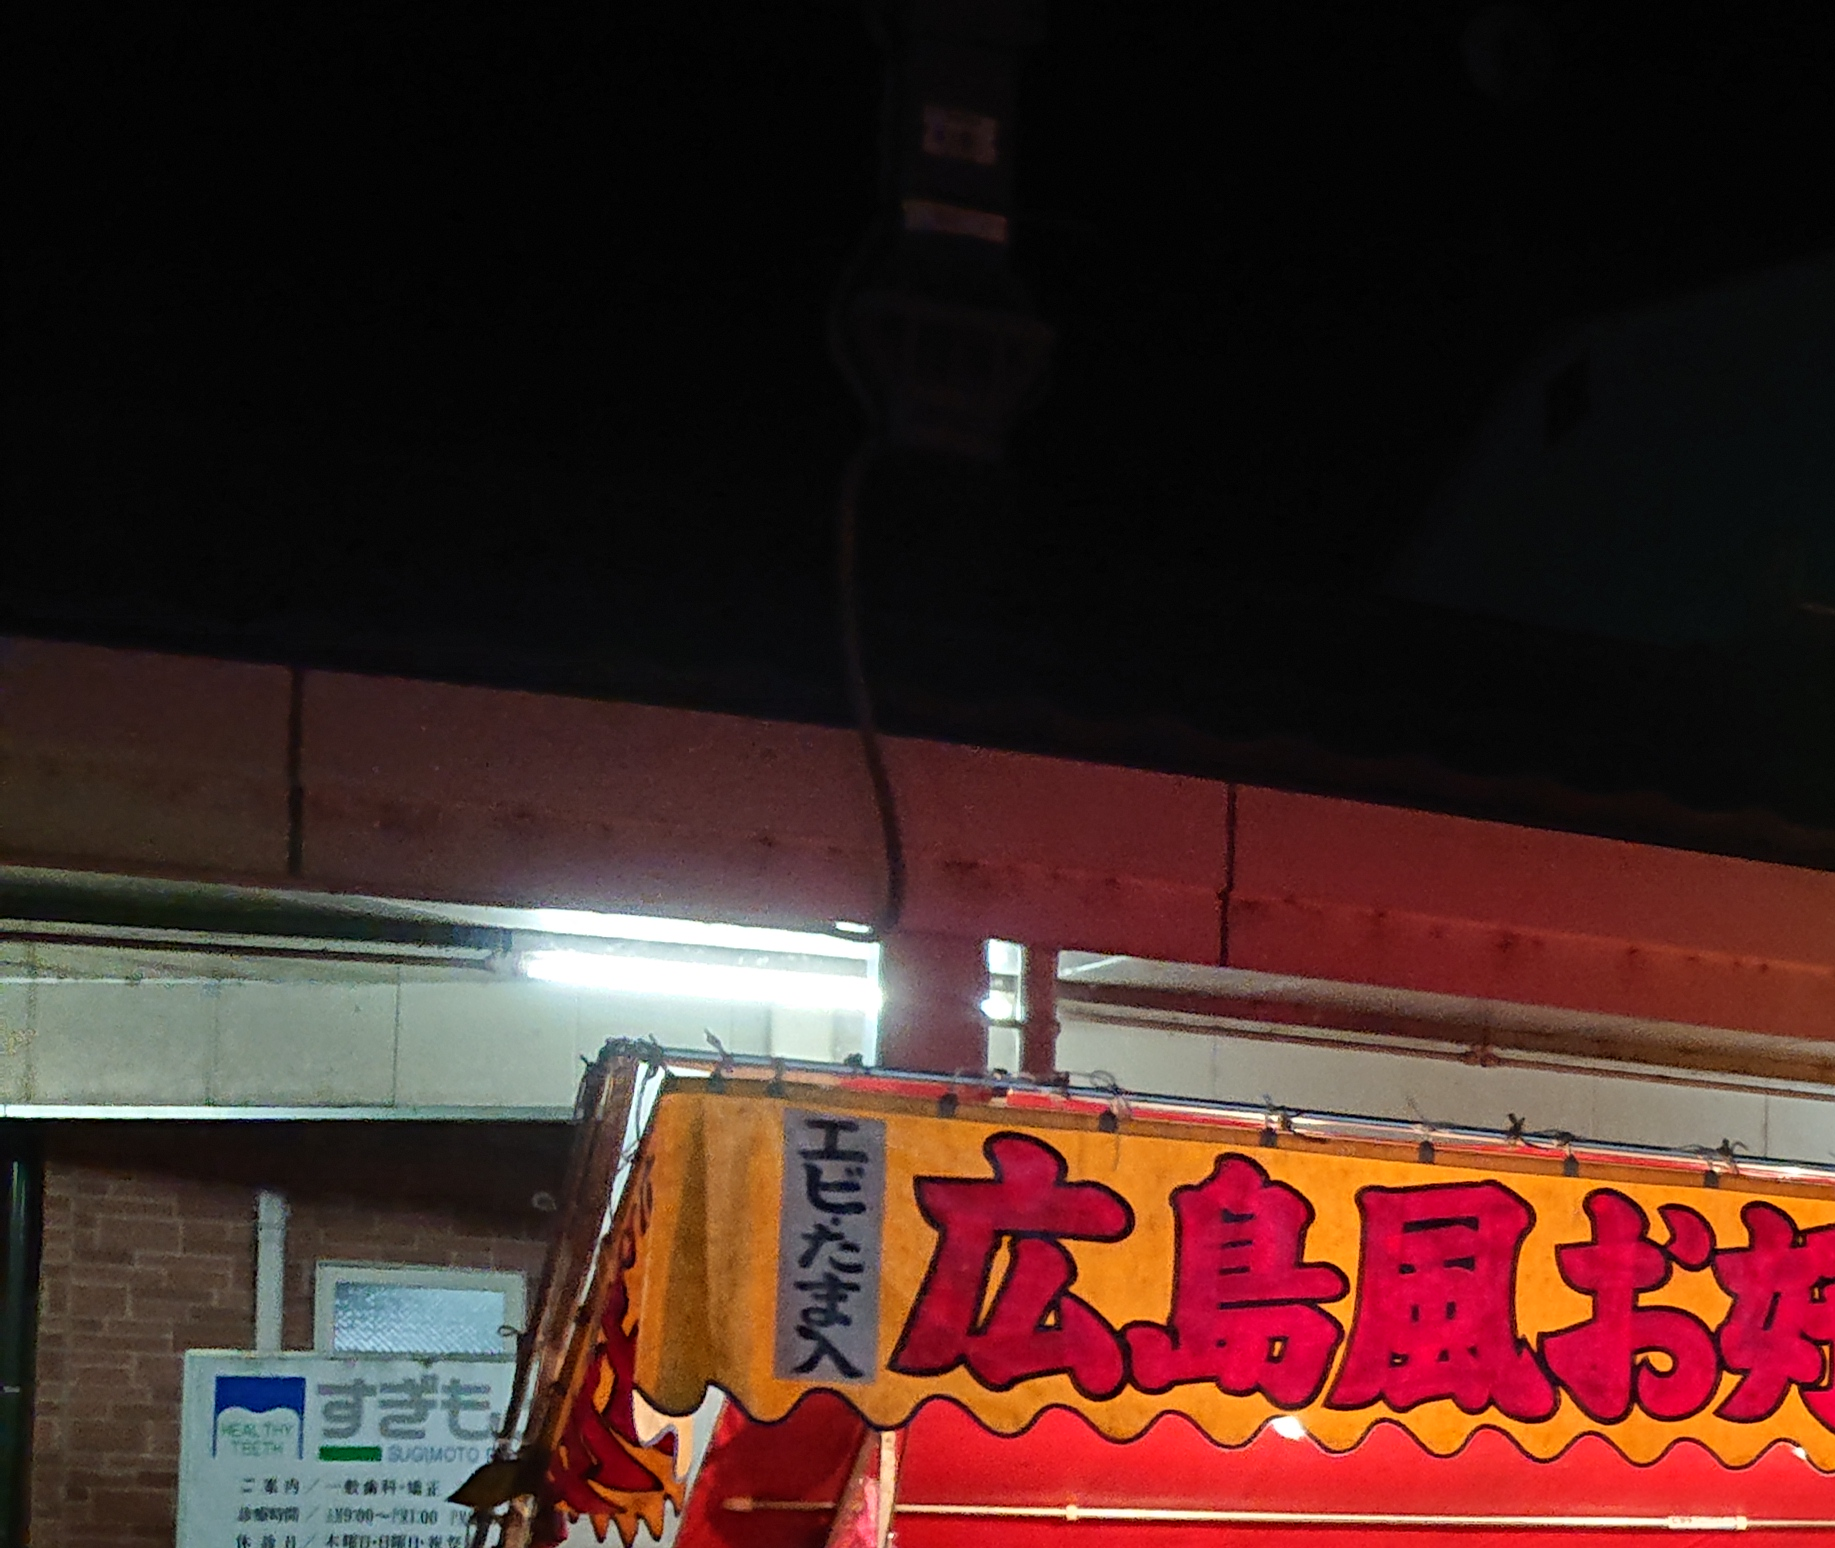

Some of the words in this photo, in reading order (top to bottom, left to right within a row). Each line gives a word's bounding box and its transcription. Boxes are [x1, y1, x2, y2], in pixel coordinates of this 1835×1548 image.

[221, 1420, 294, 1437] HEALTHY
[231, 1440, 284, 1458] TEETH
[387, 1446, 480, 1464] SUGIMOTO
